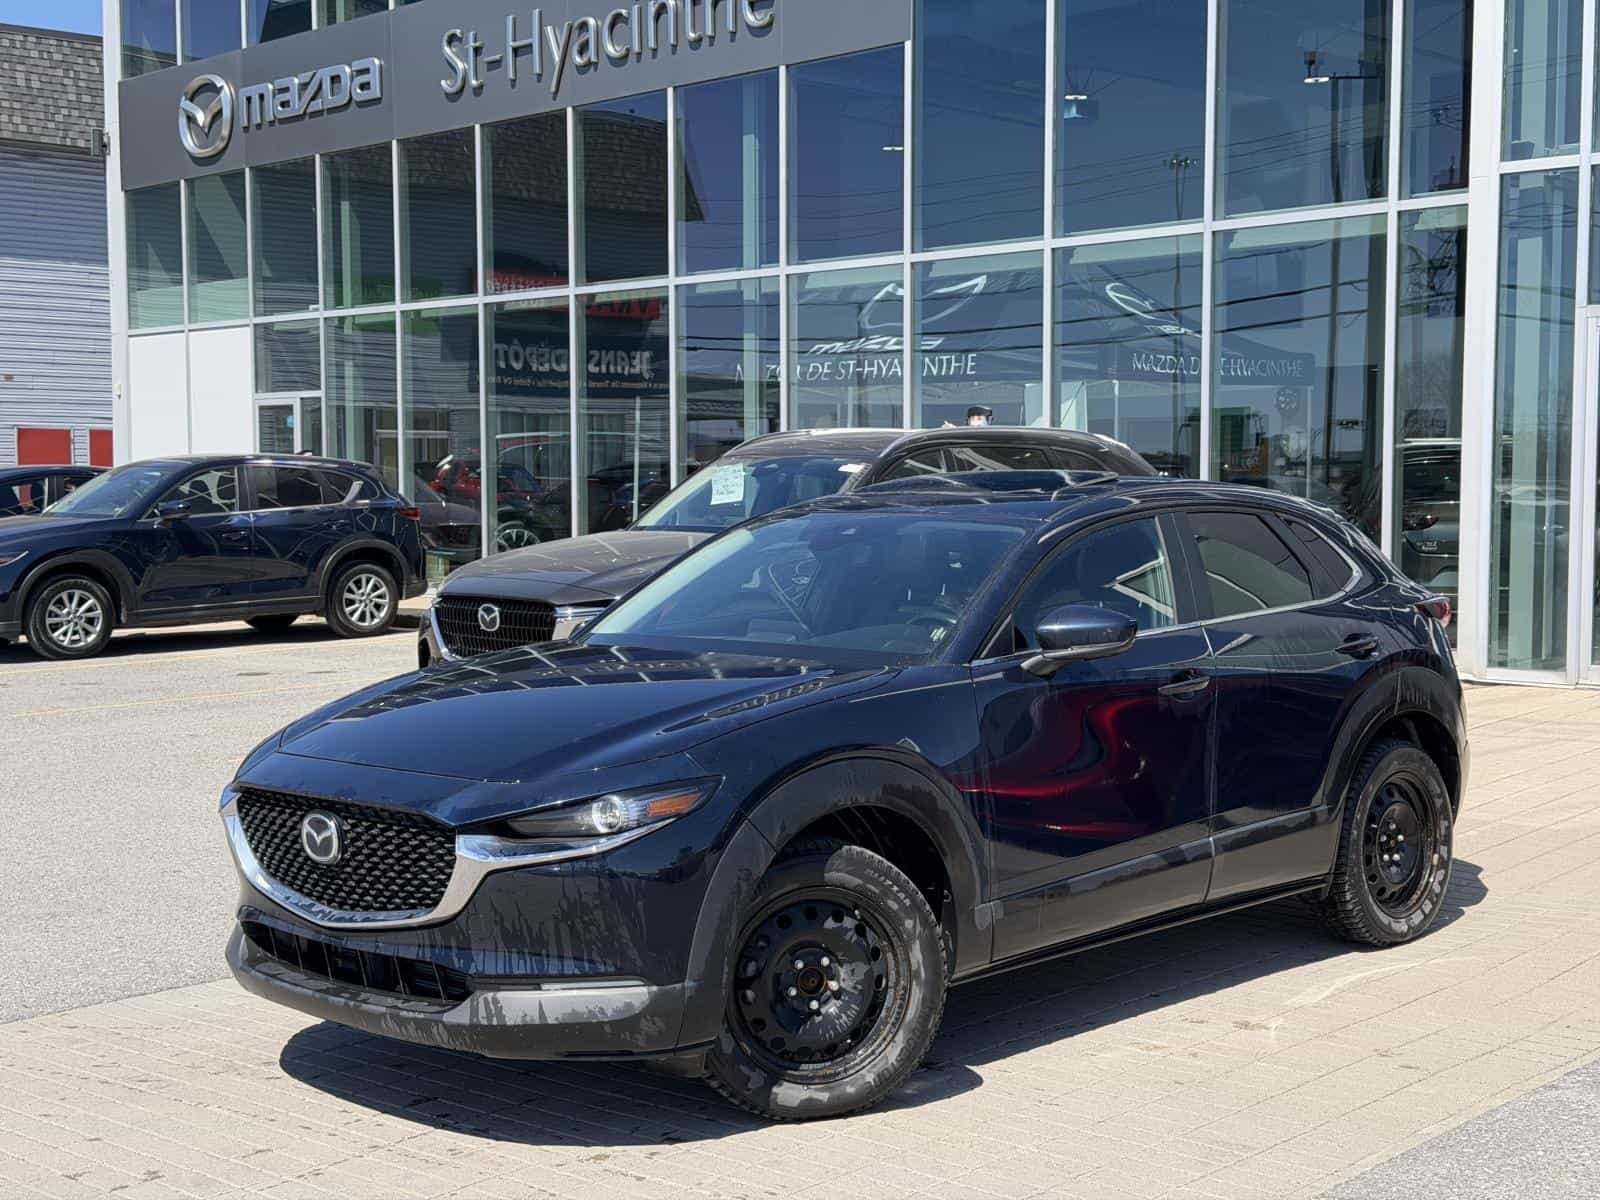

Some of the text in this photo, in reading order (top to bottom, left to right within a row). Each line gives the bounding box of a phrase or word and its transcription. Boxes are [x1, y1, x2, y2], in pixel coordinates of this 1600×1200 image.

[440, 0, 774, 95] St-Hyacinthe
[806, 362, 832, 381] DE
[835, 353, 977, 380] ST-HYANTHE
[1132, 353, 1187, 374] MAZDA
[1215, 358, 1304, 377] T-HYACINTHE
